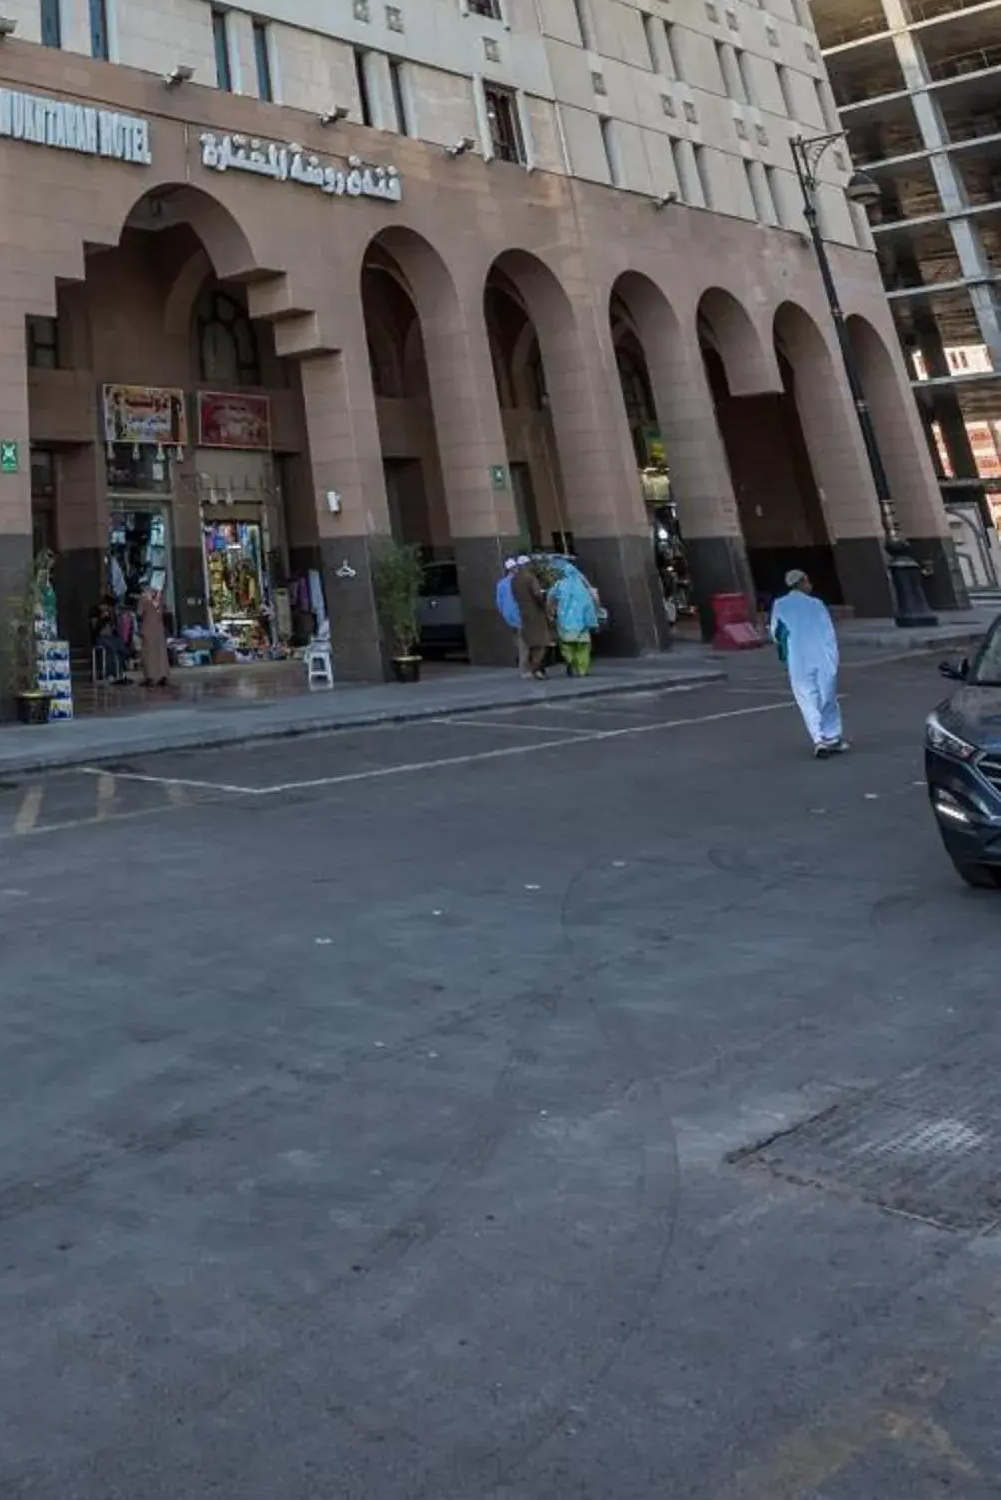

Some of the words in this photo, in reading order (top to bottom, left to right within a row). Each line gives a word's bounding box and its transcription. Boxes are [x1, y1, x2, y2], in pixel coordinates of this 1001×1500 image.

[98, 109, 152, 165] HOTEL
[200, 132, 288, 182] المختارة
[289, 142, 345, 196] روضة
[346, 155, 401, 201] فندق
